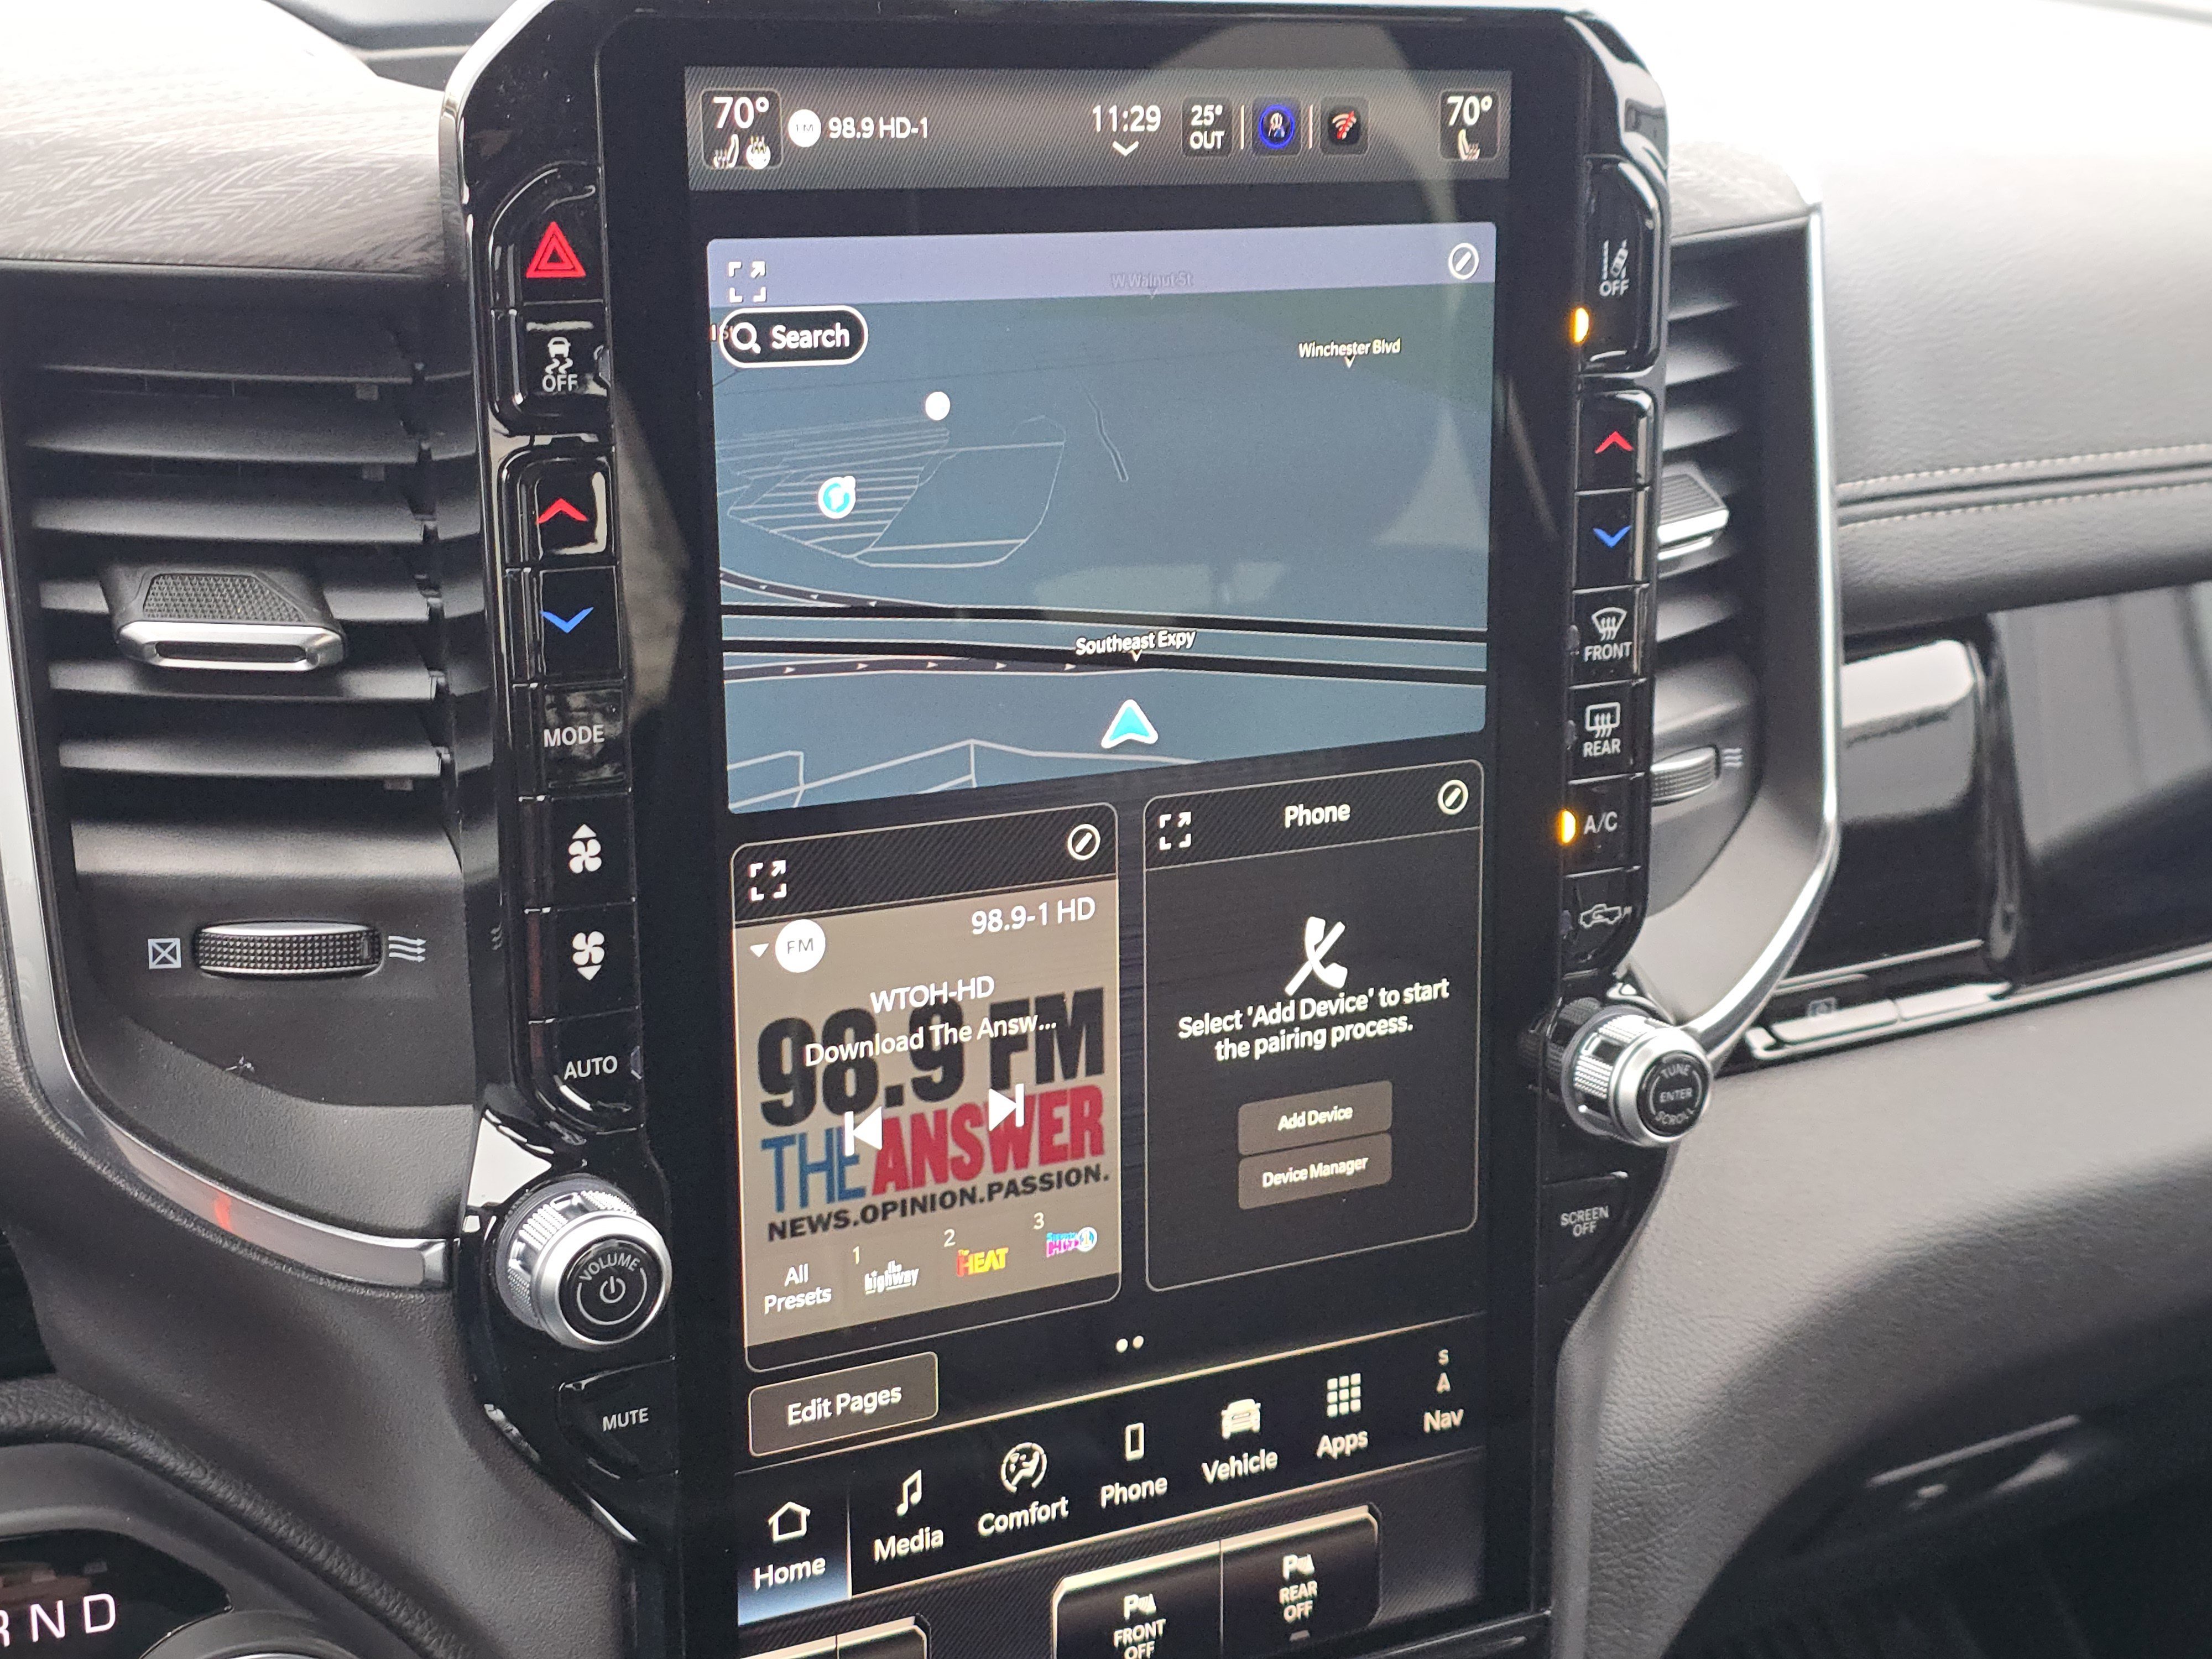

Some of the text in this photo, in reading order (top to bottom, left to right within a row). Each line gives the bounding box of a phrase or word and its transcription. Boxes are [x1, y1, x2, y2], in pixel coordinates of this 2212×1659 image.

[713, 96, 769, 129] 70°
[1092, 105, 1161, 133] 11:29
[1191, 104, 1223, 126] 25°
[1447, 96, 1493, 126] 70°
[829, 117, 875, 139] 98.9
[879, 117, 929, 139] HD-1
[1190, 131, 1225, 150] OUT
[1129, 272, 1175, 288] Walnut
[1177, 270, 1193, 287] St
[1599, 279, 1630, 297] OFF
[771, 322, 851, 349] Search
[1298, 338, 1401, 359] Winchester Blvd
[542, 374, 578, 393] OFF
[1076, 630, 1197, 656] Southeast Expy
[1584, 641, 1632, 662] FRONT
[544, 724, 605, 747] MODE
[1583, 738, 1621, 758] REAR
[1285, 803, 1351, 828] Phone
[1584, 811, 1618, 835] A/C
[971, 896, 1096, 936] 98.9-1 HD
[786, 937, 815, 955] FM
[870, 975, 995, 1013] WTOH-HD
[1178, 978, 1451, 1040] Select 'Add Device' to start
[805, 1014, 1058, 1068] Download The Answ...
[988, 987, 1105, 1091] FM
[1215, 1014, 1414, 1062] the pairing process.
[564, 1055, 618, 1081] AUTO
[1661, 1063, 1691, 1079] TUNE
[1660, 1087, 1693, 1103] ENTER
[1277, 1104, 1353, 1131] Add Device
[1655, 1108, 1695, 1126] SCROLL
[761, 1084, 1106, 1213] THE ANSWER
[1262, 1156, 1369, 1188] Device Manager
[1034, 1212, 1045, 1230] 3
[1561, 1206, 1609, 1227] SCREEN
[1572, 1220, 1597, 1238] OFF
[943, 1228, 956, 1248] 2
[578, 1252, 641, 1282] VOLUME
[852, 1245, 860, 1265] 1
[957, 1247, 1009, 1277] HEAT
[784, 1264, 808, 1285] All
[764, 1287, 832, 1314] Presets
[787, 1385, 902, 1427] Edit Pages
[603, 1407, 649, 1432] MUTE
[1423, 1408, 1464, 1434] Nav
[1316, 1430, 1369, 1460] Apps
[1201, 1448, 1279, 1484] Vehicle
[1100, 1476, 1168, 1509] Phone
[977, 1495, 1070, 1537] Comfort
[873, 1526, 945, 1563] Media
[753, 1555, 826, 1592] Home
[1279, 1580, 1318, 1605] REAR
[30, 1600, 65, 1642] N
[84, 1593, 116, 1633] D
[1282, 1600, 1314, 1624] OFF
[1114, 1618, 1167, 1649] FRONT
[1124, 1640, 1155, 1659] OFF
